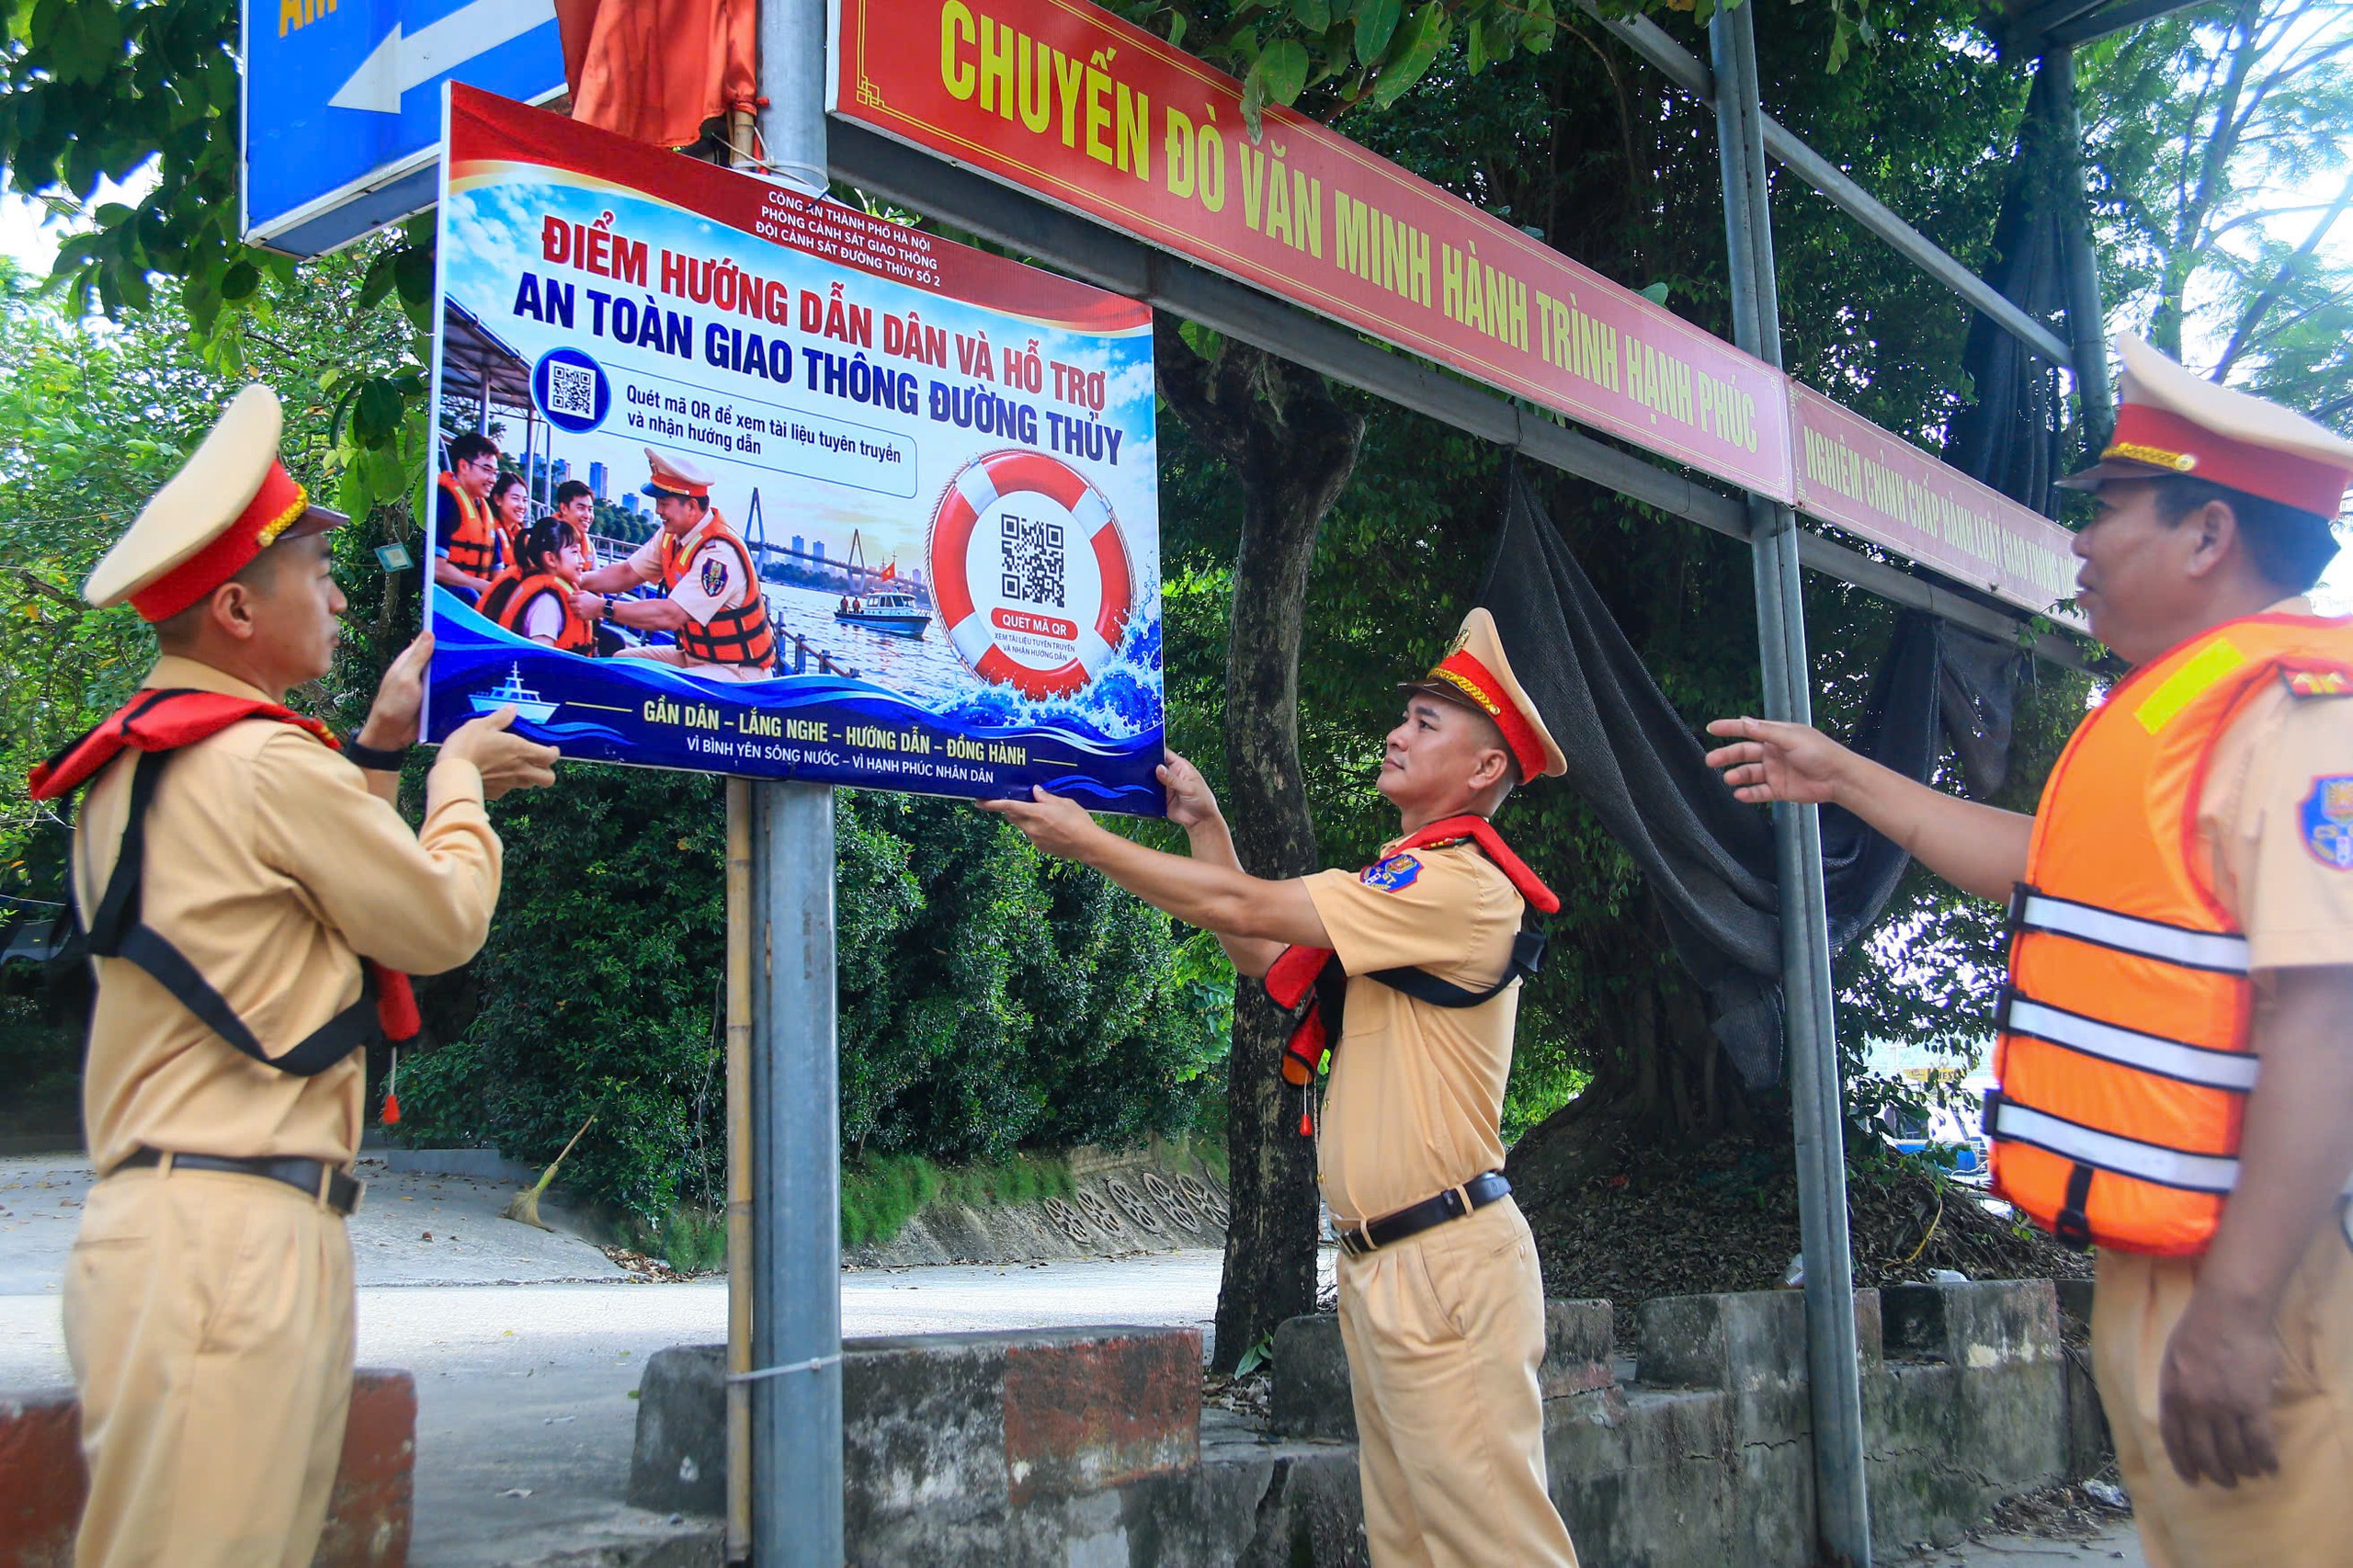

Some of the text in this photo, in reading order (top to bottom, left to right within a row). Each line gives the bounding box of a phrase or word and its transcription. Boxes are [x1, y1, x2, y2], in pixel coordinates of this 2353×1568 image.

[756, 222, 940, 287] ĐỘI CẢNH SÁT ĐƯỜNG THỦY SỐ 2
[762, 206, 938, 269] PHÒNG CẢNH SÁT GIAO THÔNG
[768, 191, 930, 253] CÔNG AN THÀNH PHỐ HÀ NỘI
[940, 0, 1757, 453] CHUYẾN ĐÒ VĂN MINH HÀNH TRÌNH HẠNH PHÚC
[541, 210, 1106, 420] ĐIỂM HƯỚNG DẪN DÂN VÀ HỖ TRỢ
[513, 271, 1123, 466] AN TOÀN GIAO THÔNG ĐƯỜNG THỦY
[627, 384, 901, 464] Quét mã QR để xem tài liệu tuyên truyền
[627, 411, 761, 455] và nhận hướng dẫn
[1803, 425, 1863, 503] NGHIÊM
[1864, 449, 1906, 523] CHỈNH
[1907, 472, 1938, 539] CHẤP
[995, 632, 1007, 641] XEM
[1002, 613, 1067, 636] QUÉT MÃ QR
[643, 695, 679, 725] GẦN
[685, 703, 719, 731] DÂN
[739, 706, 781, 737] LẮNG
[787, 718, 828, 743] NGHE
[846, 724, 896, 751] HƯỚNG
[901, 725, 930, 755] DẪN
[946, 733, 984, 762] ĐỒNG
[988, 740, 1026, 766] HÀNH
[687, 734, 699, 752] VÌ
[703, 738, 733, 756] BÌNH
[736, 741, 761, 758] YÊN
[764, 744, 801, 762] SÔNG
[803, 749, 840, 767] NƯỚC
[852, 753, 864, 769] VÌ
[867, 758, 899, 774] HẠNH
[903, 760, 933, 777] PHÚC
[936, 764, 968, 781] NHÂN
[971, 768, 994, 784] DÂN
